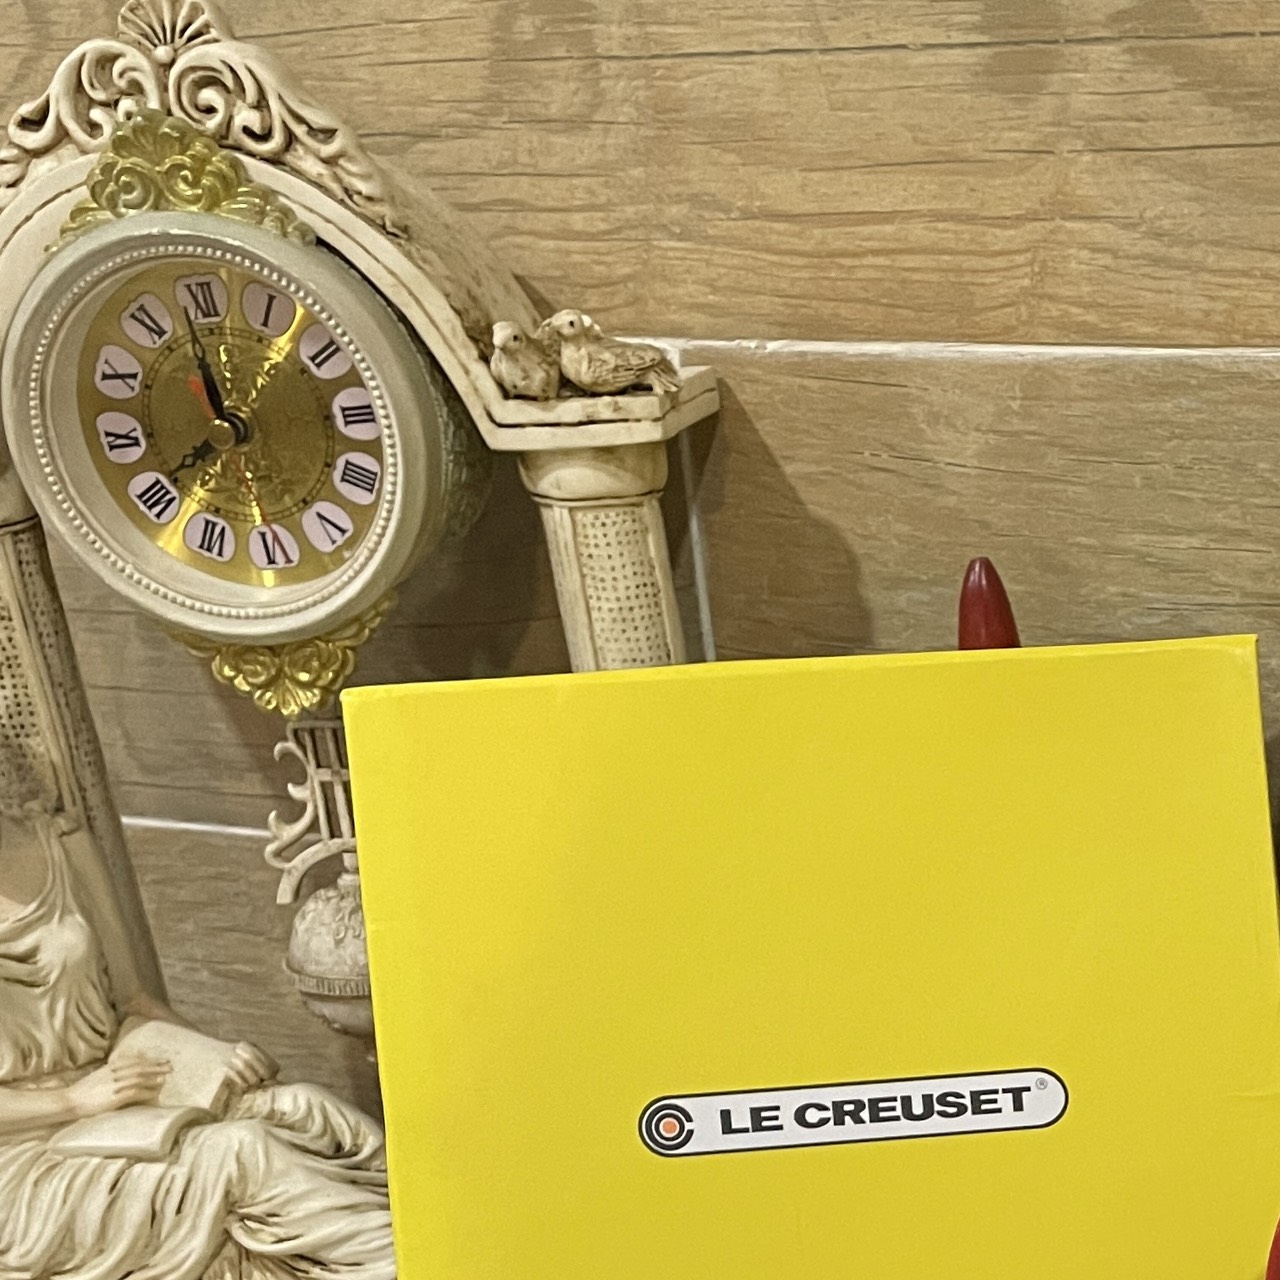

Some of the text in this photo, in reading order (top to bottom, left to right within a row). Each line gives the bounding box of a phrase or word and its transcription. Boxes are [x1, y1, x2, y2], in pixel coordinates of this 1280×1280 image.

[184, 281, 221, 319] XII
[260, 293, 276, 328] I
[129, 304, 169, 345] XI
[307, 337, 341, 371] II
[101, 357, 139, 392] X
[339, 404, 377, 428] III
[104, 427, 141, 452] IX
[340, 458, 378, 495] IIII
[135, 476, 177, 521] VIII
[197, 516, 226, 558] VII
[316, 511, 349, 546] V
[720, 1085, 1032, 1136] LE CREUSET
